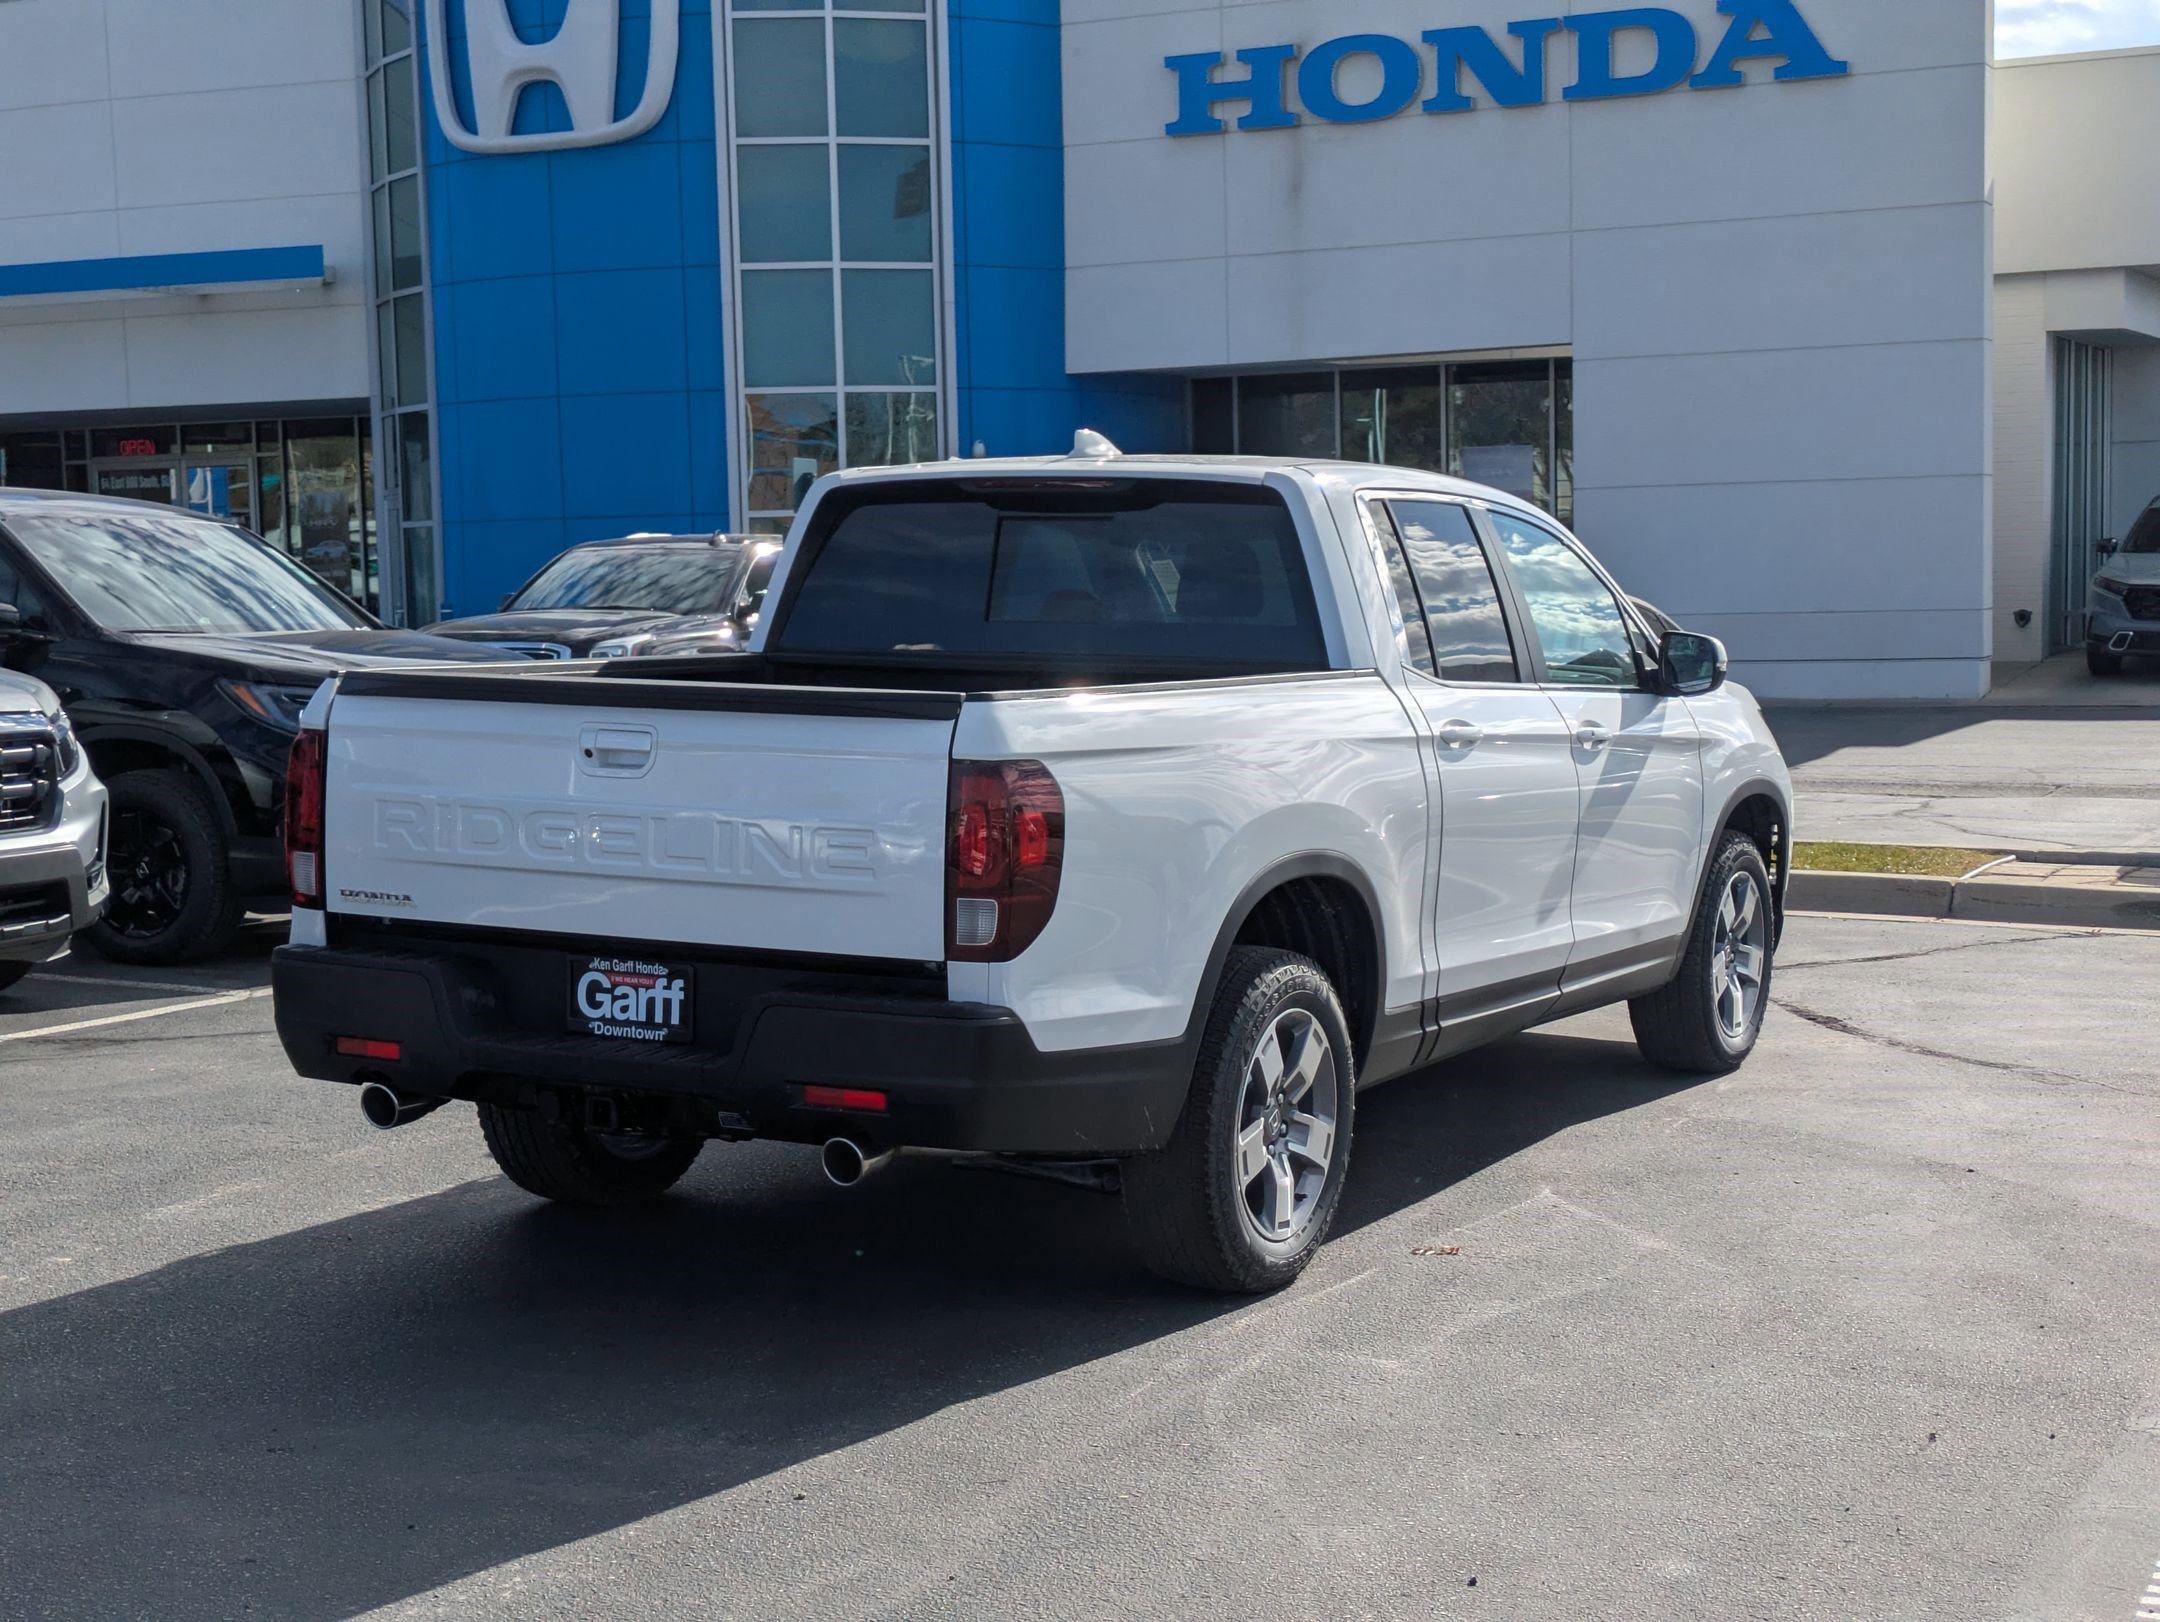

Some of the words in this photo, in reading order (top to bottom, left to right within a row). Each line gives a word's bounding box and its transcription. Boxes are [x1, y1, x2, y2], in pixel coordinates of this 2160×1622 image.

[1164, 0, 1849, 137] HONDA
[119, 439, 156, 456] OPEN
[373, 798, 876, 882] RIDGELINE
[593, 957, 611, 971] Ken
[612, 959, 634, 972] Garff
[635, 961, 665, 975] Honda
[577, 970, 685, 1025] Garff
[593, 1021, 665, 1041] Downtown
